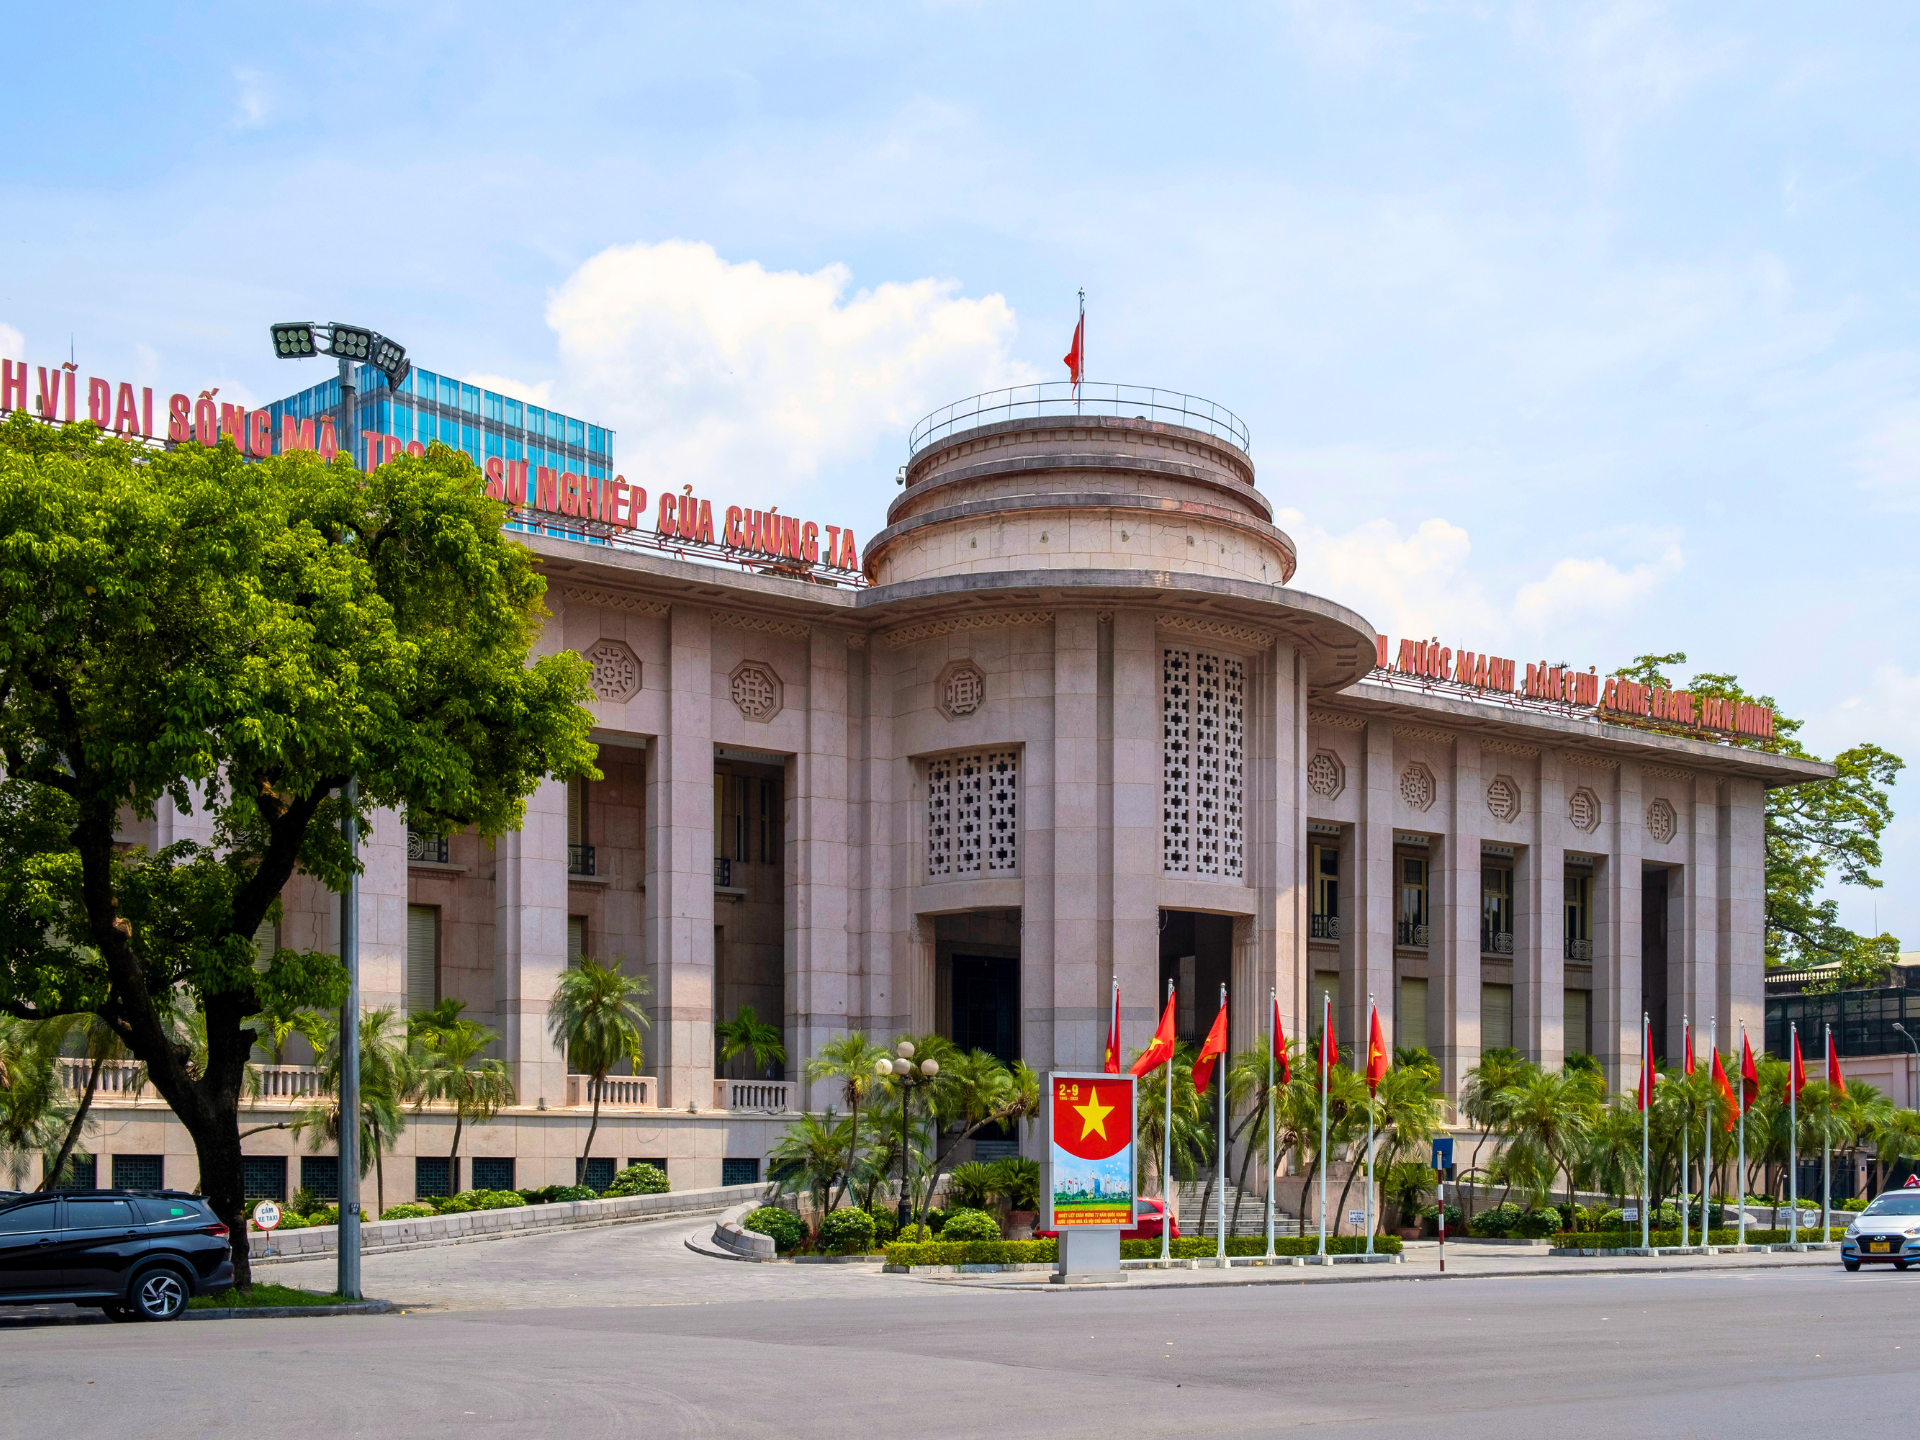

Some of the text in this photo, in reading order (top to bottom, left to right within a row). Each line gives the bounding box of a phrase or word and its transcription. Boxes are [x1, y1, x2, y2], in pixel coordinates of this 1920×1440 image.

[38, 361, 78, 422] VĨ
[88, 376, 153, 441] ĐẠI
[169, 388, 272, 456] SỐNG
[536, 466, 647, 533] NGHIỆP
[658, 484, 715, 543] CỦA
[726, 506, 819, 562] CHÚNG
[826, 525, 858, 570] TA
[1400, 636, 1452, 680] NƯỚC
[1526, 660, 1561, 699] DÂN
[1605, 675, 1650, 716] CÔNG
